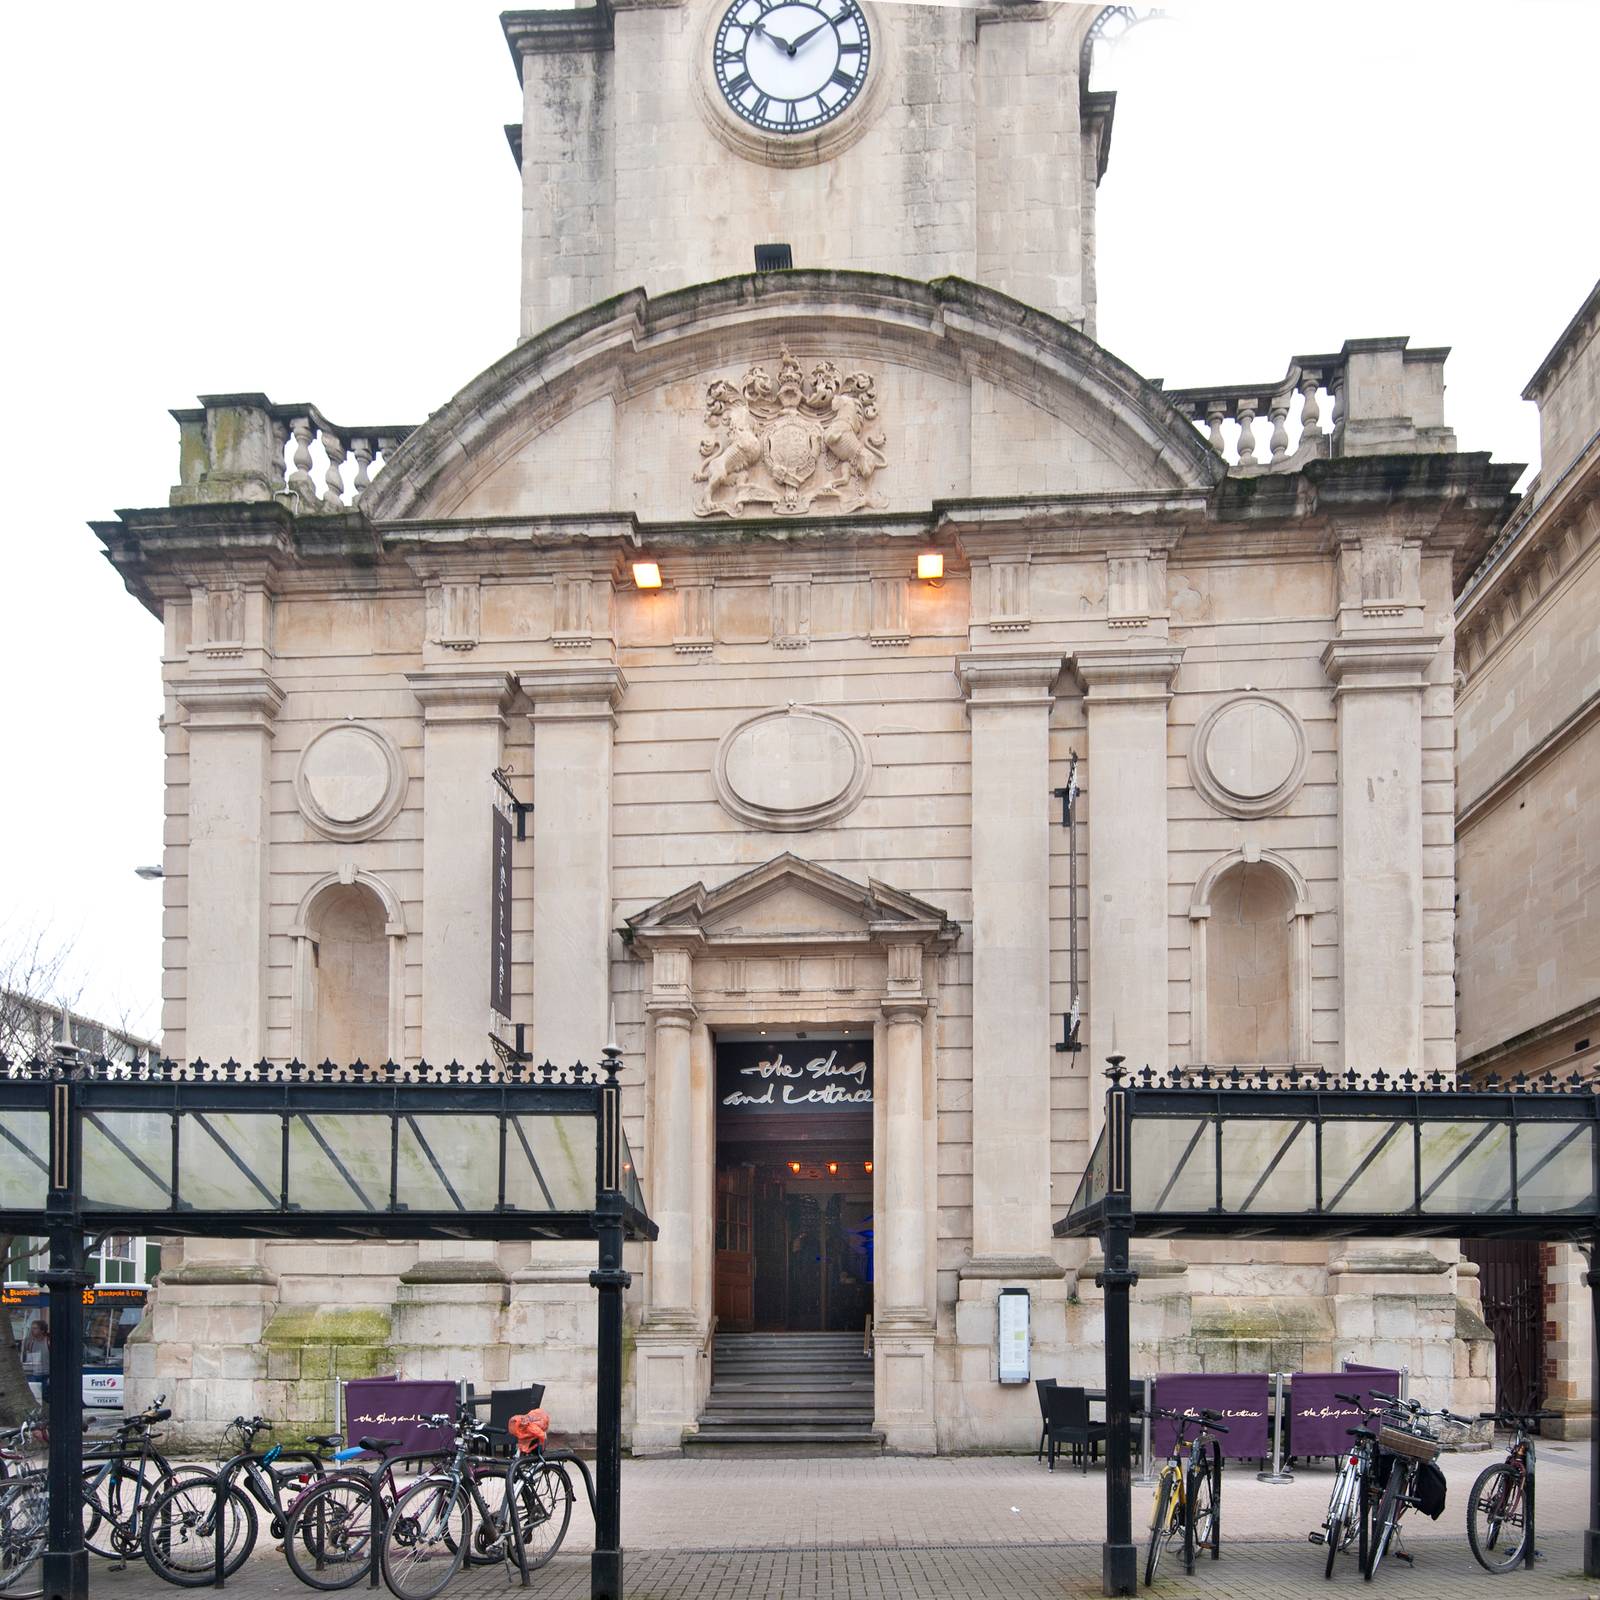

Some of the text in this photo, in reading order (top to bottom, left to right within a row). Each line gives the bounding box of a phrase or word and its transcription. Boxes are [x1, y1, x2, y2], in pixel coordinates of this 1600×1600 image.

[816, 95, 831, 114] V
[785, 102, 799, 124] VI
[739, 1049, 868, 1085] the Slug
[722, 1082, 875, 1106] and Lettuce
[82, 1290, 95, 1304] 35
[91, 1379, 106, 1387] First
[353, 1413, 376, 1423] the
[376, 1412, 397, 1425] Slug
[397, 1414, 415, 1422] and
[1183, 1407, 1200, 1418] Slu
[1296, 1407, 1320, 1417] the
[1320, 1406, 1340, 1419] Slug
[1341, 1407, 1359, 1415] and
